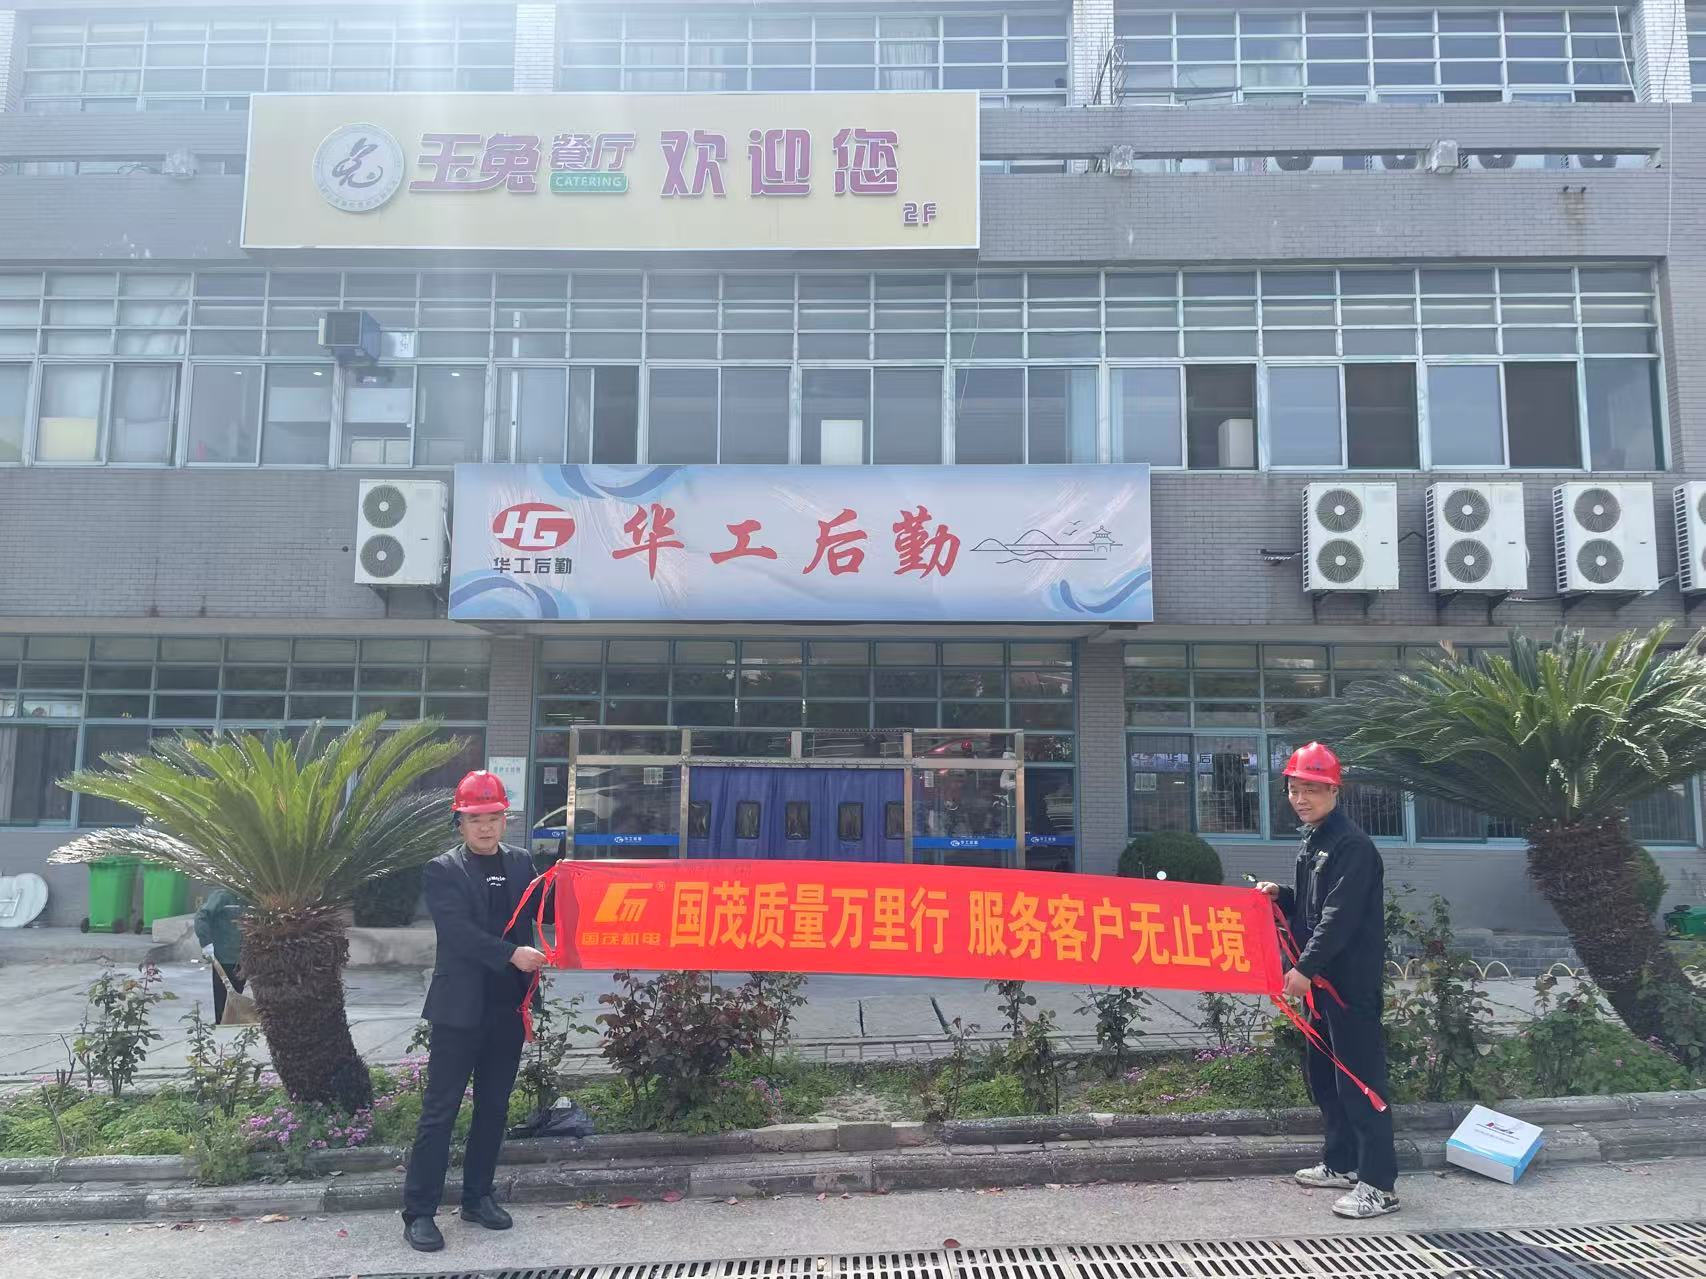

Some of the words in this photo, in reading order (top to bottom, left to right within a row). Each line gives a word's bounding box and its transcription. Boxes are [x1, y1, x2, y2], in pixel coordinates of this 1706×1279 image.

[555, 176, 622, 188] CATERING
[659, 128, 899, 195] 欢迎您
[903, 202, 937, 224] 2F
[612, 502, 961, 581] 华工后勤
[493, 557, 572, 574] 华工后勤
[669, 880, 950, 954] 国茂质量万里行
[968, 890, 1251, 973] 服务客户无止境
